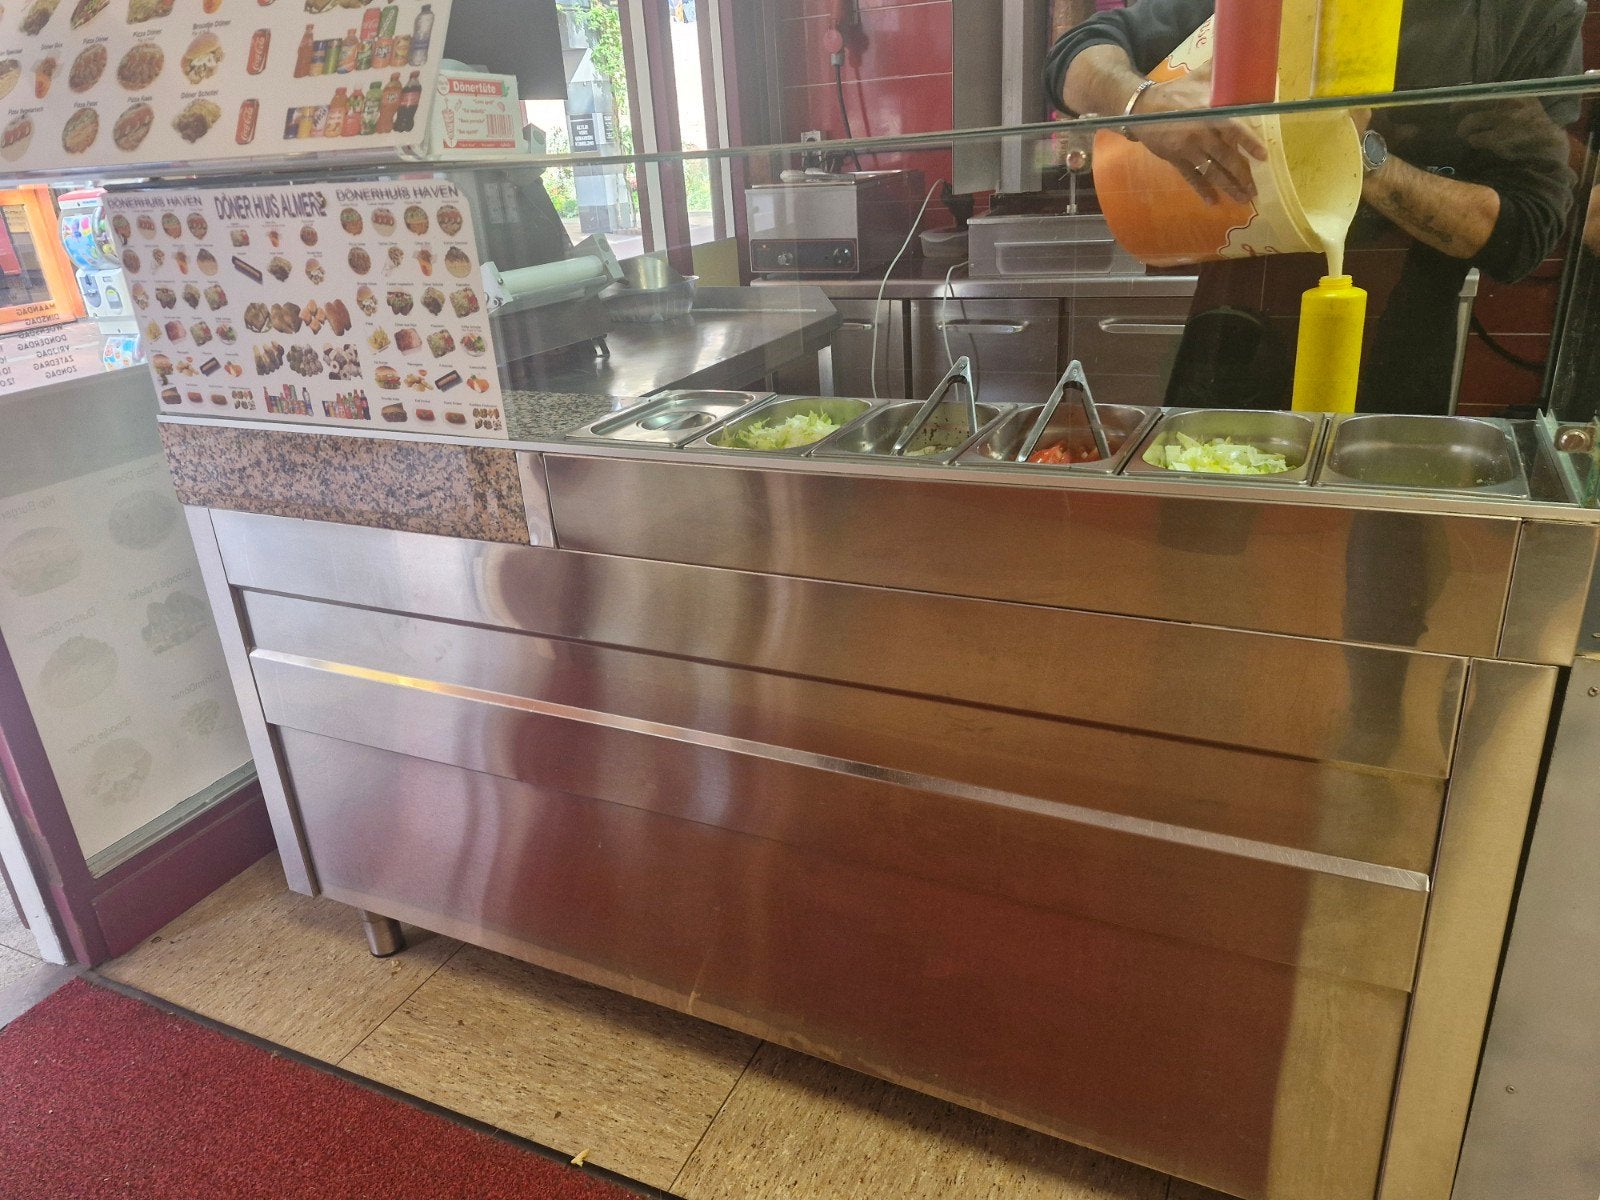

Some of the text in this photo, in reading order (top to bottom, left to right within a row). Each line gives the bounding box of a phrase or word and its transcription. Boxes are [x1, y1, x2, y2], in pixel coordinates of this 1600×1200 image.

[452, 79, 498, 95] Dönertüte
[412, 184, 459, 199] HAVEN
[166, 195, 203, 208] HAVEN
[252, 193, 281, 219] HUIS
